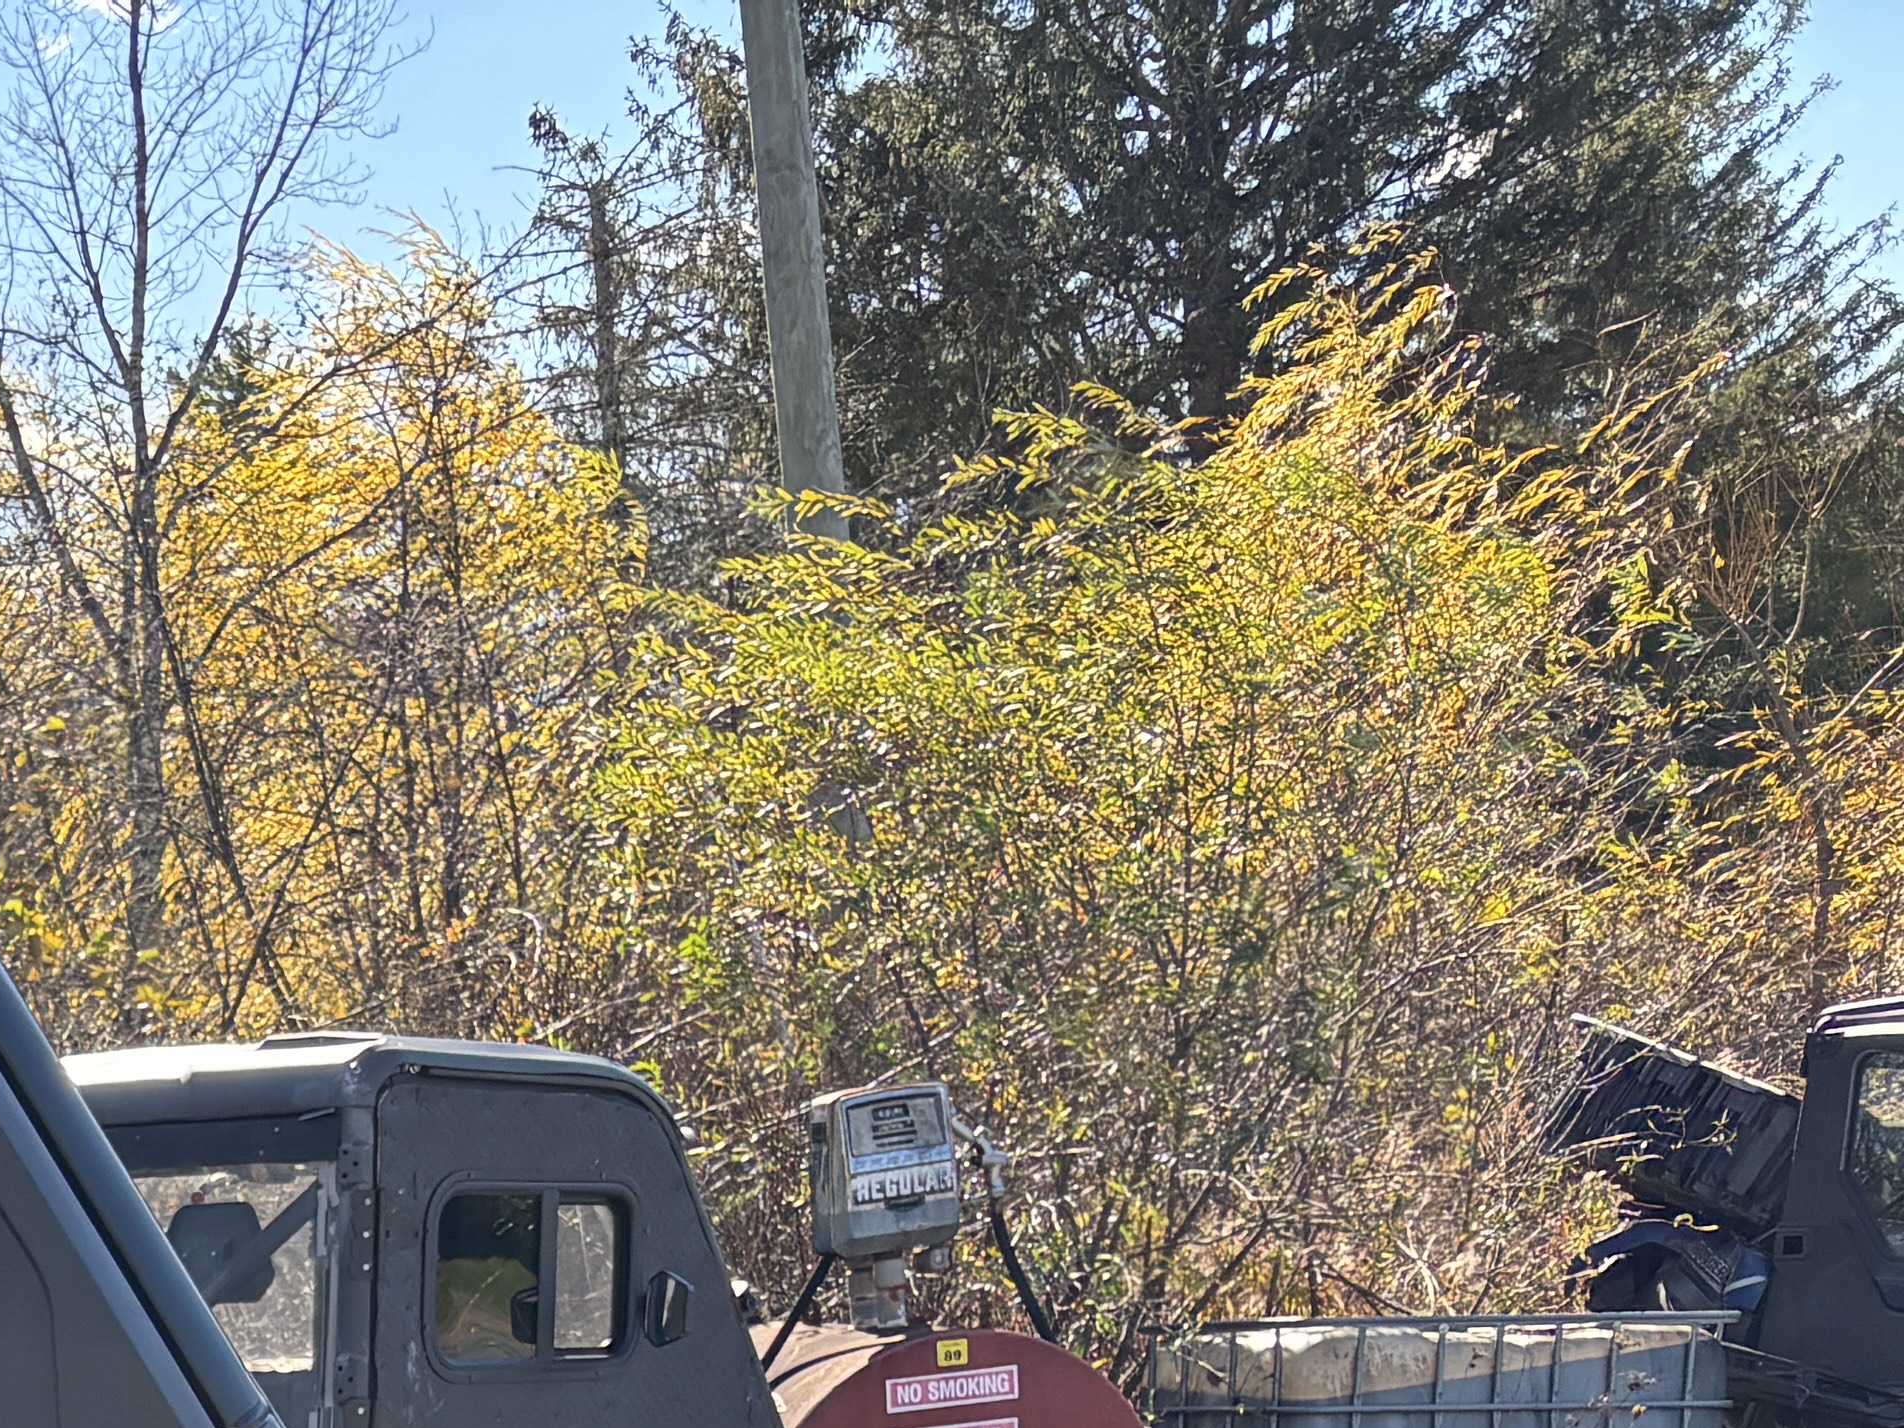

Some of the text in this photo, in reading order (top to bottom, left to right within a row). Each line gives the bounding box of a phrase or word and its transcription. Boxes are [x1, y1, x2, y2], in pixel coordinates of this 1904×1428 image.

[855, 1165, 954, 1202] REGULAR
[896, 1373, 1010, 1404] NO SMOKING
